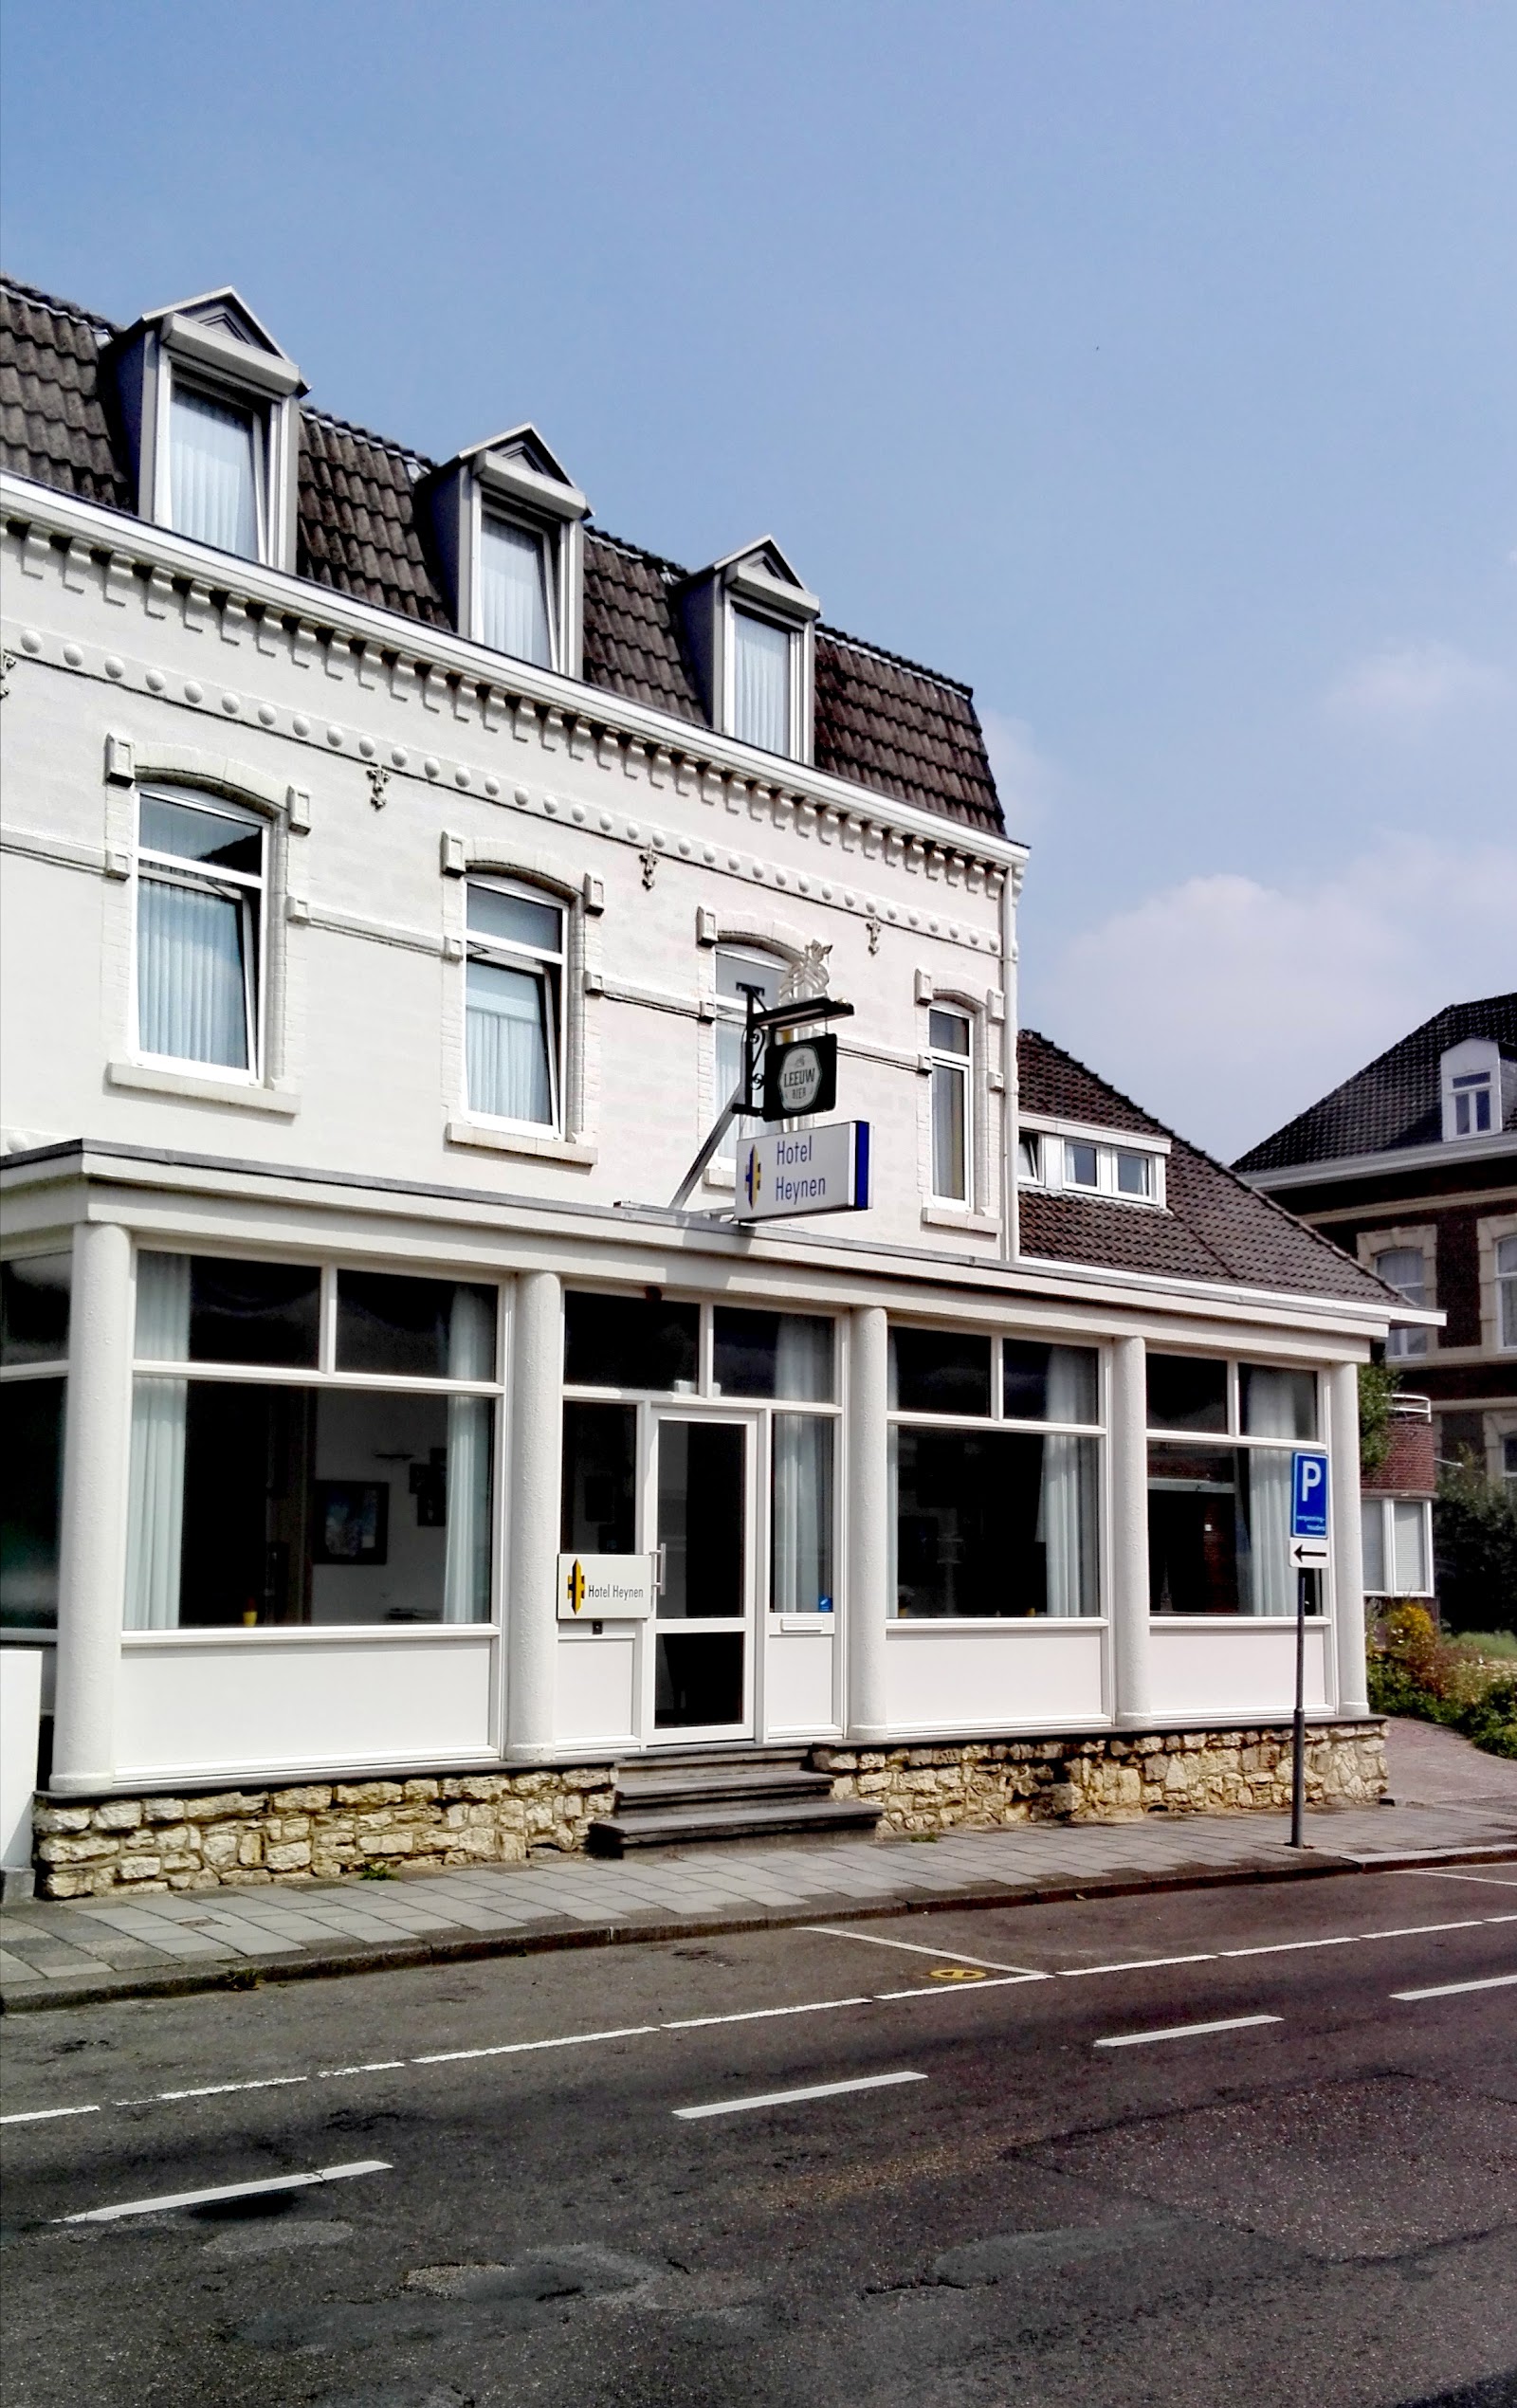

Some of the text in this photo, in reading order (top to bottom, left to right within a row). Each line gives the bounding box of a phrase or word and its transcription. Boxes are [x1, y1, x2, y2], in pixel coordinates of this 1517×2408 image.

[784, 1068, 814, 1087] LEEUW
[777, 1135, 812, 1165] Hotel
[776, 1177, 826, 1205] Heynen
[1302, 1460, 1322, 1502] P
[588, 1583, 644, 1601] Hotel Heynen
